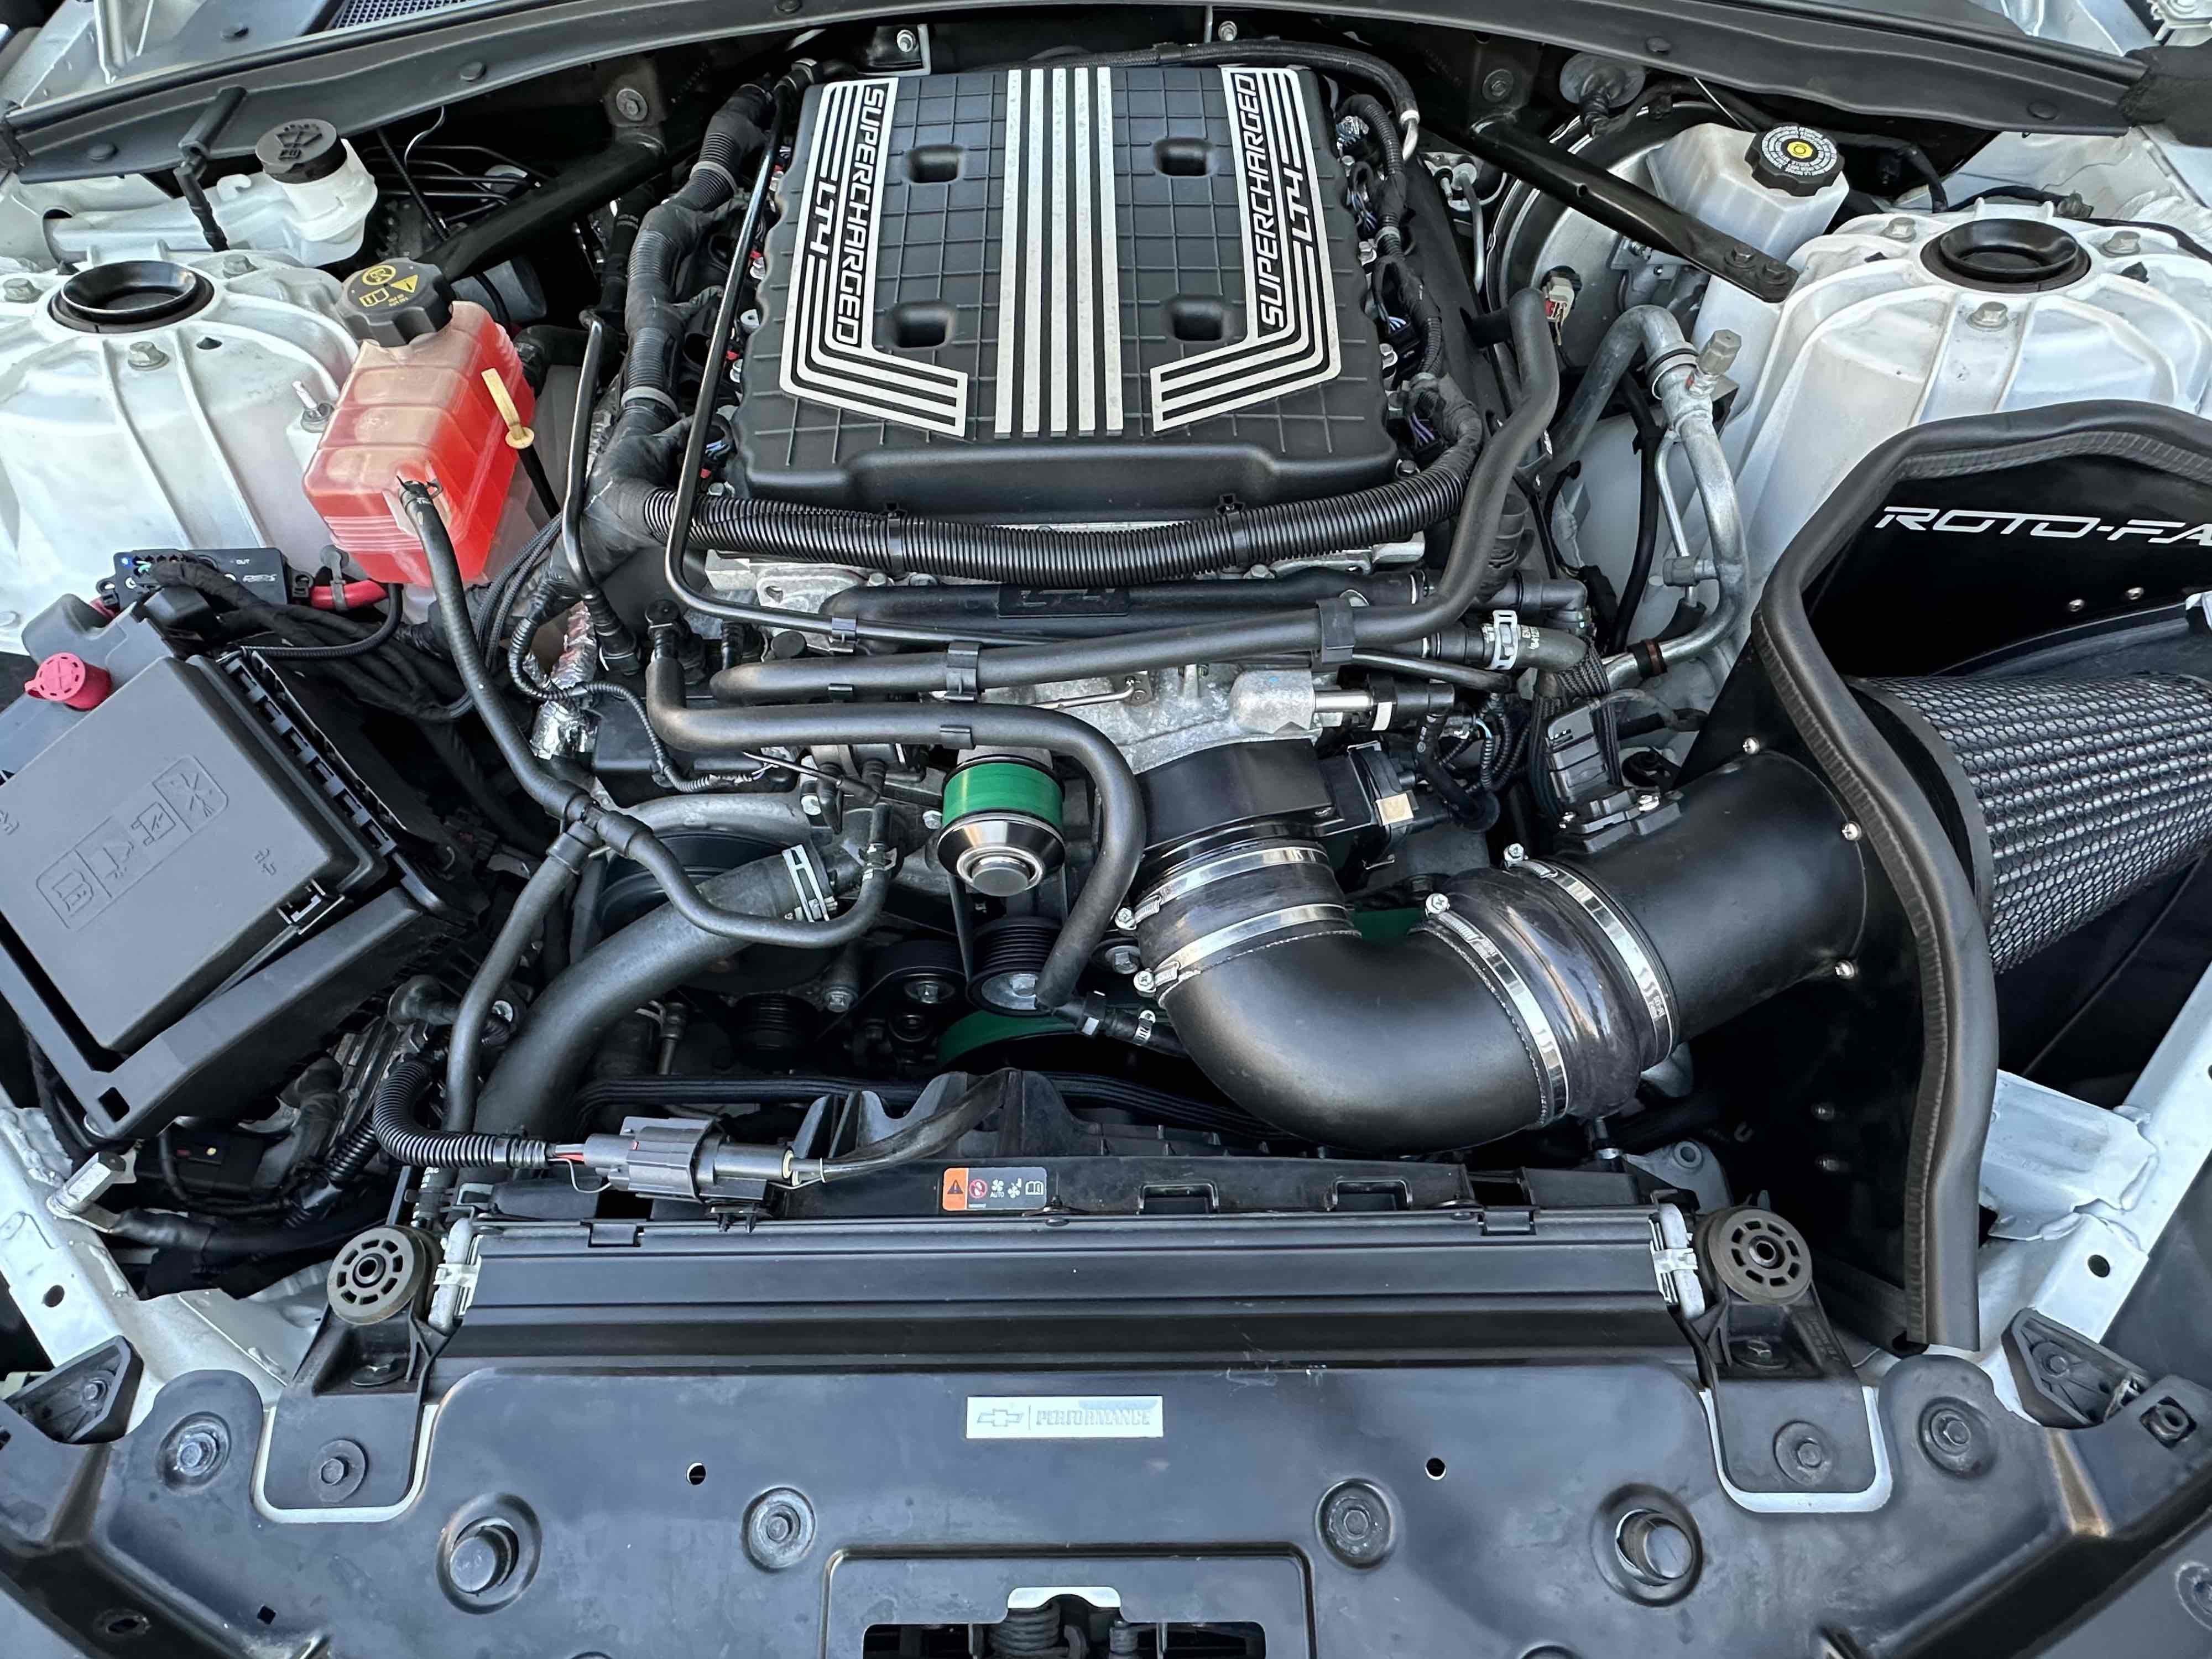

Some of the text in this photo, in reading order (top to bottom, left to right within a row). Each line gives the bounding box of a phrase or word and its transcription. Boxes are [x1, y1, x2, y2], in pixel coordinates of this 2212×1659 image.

[810, 183, 836, 254] LT4
[836, 87, 884, 346] SUPERCHARGED
[1235, 74, 1284, 328] SUPERCHARGED
[1285, 168, 1313, 242] LT4
[1035, 1410, 1151, 1425] PERFORMANCE
